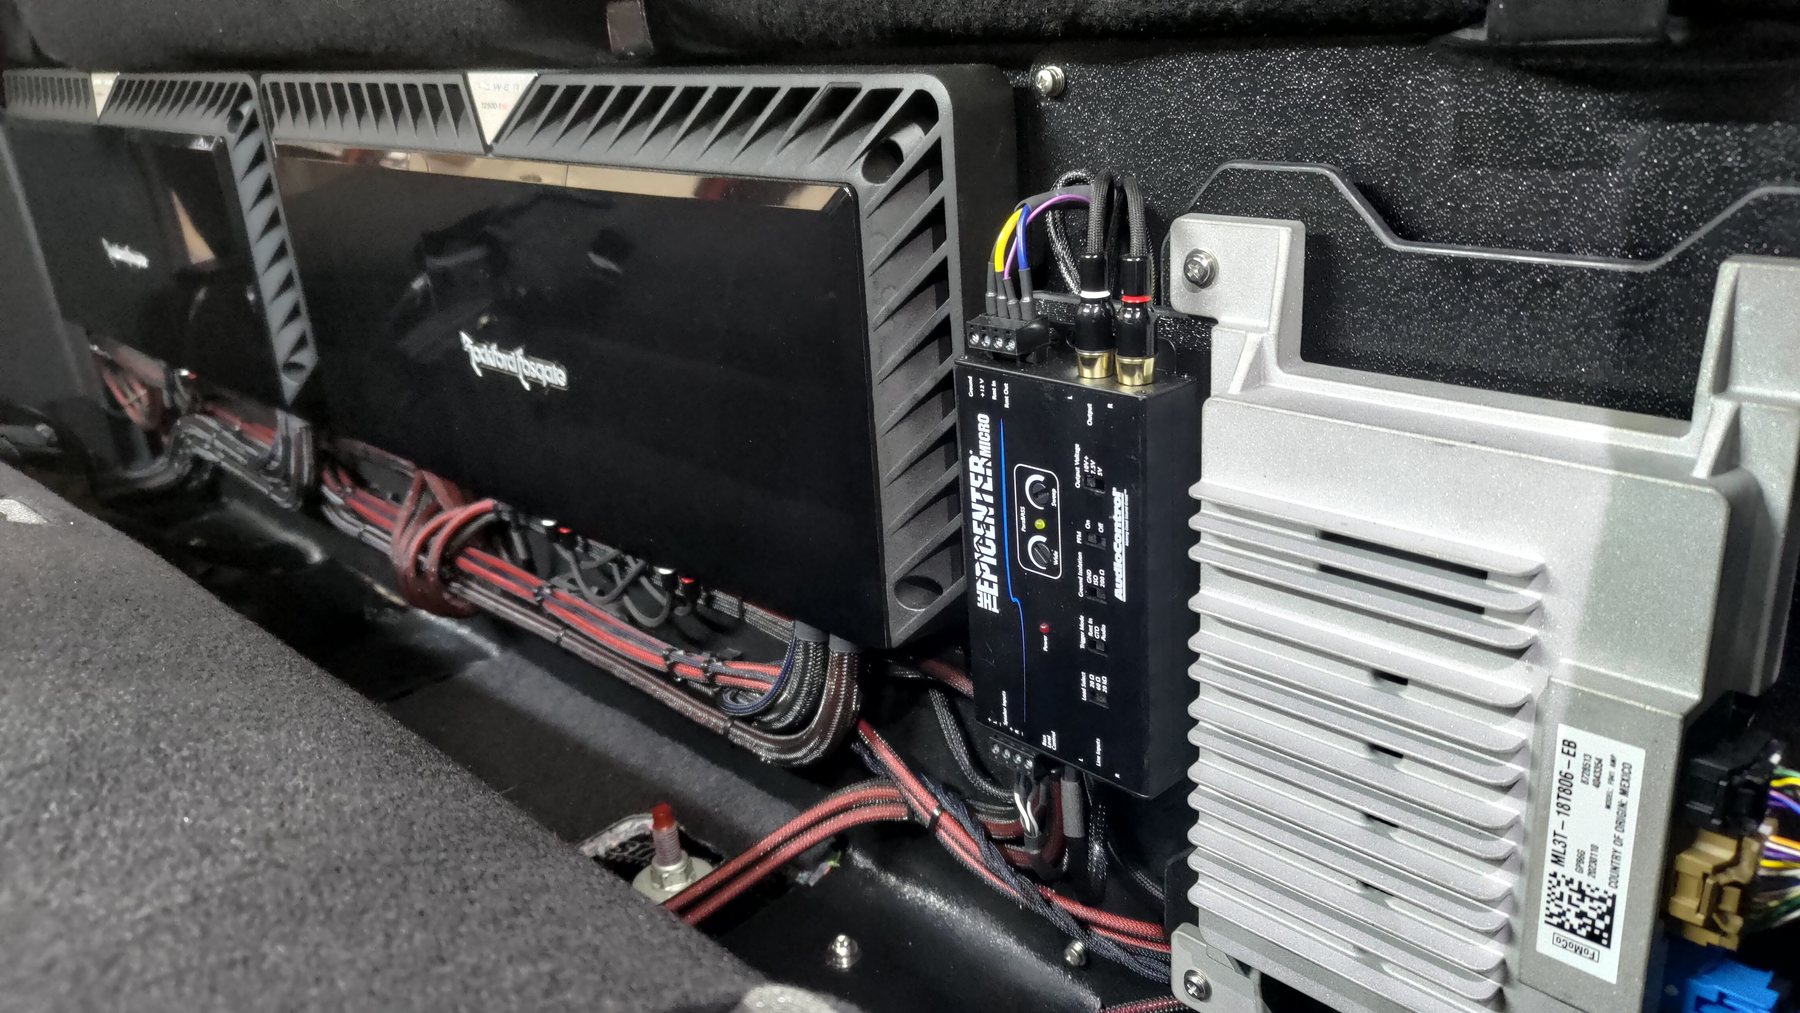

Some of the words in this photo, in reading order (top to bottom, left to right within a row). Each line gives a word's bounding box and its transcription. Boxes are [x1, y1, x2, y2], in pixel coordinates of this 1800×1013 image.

[991, 380, 996, 388] In
[1086, 403, 1094, 426] Output
[977, 413, 992, 458] MICRO
[1096, 466, 1103, 476] 5V
[969, 454, 999, 598] EPICENTER
[1084, 520, 1090, 530] On
[1112, 487, 1125, 602] AudioControl
[976, 588, 1000, 614] THE
[1090, 680, 1095, 688] 20
[1102, 685, 1108, 694] 20
[1618, 762, 1633, 798] MEXICO
[1614, 800, 1628, 833] ORIGIN:
[1614, 834, 1624, 848] OF
[1608, 848, 1623, 890] COUNTRY
[1555, 935, 1596, 961] FoMoCo
